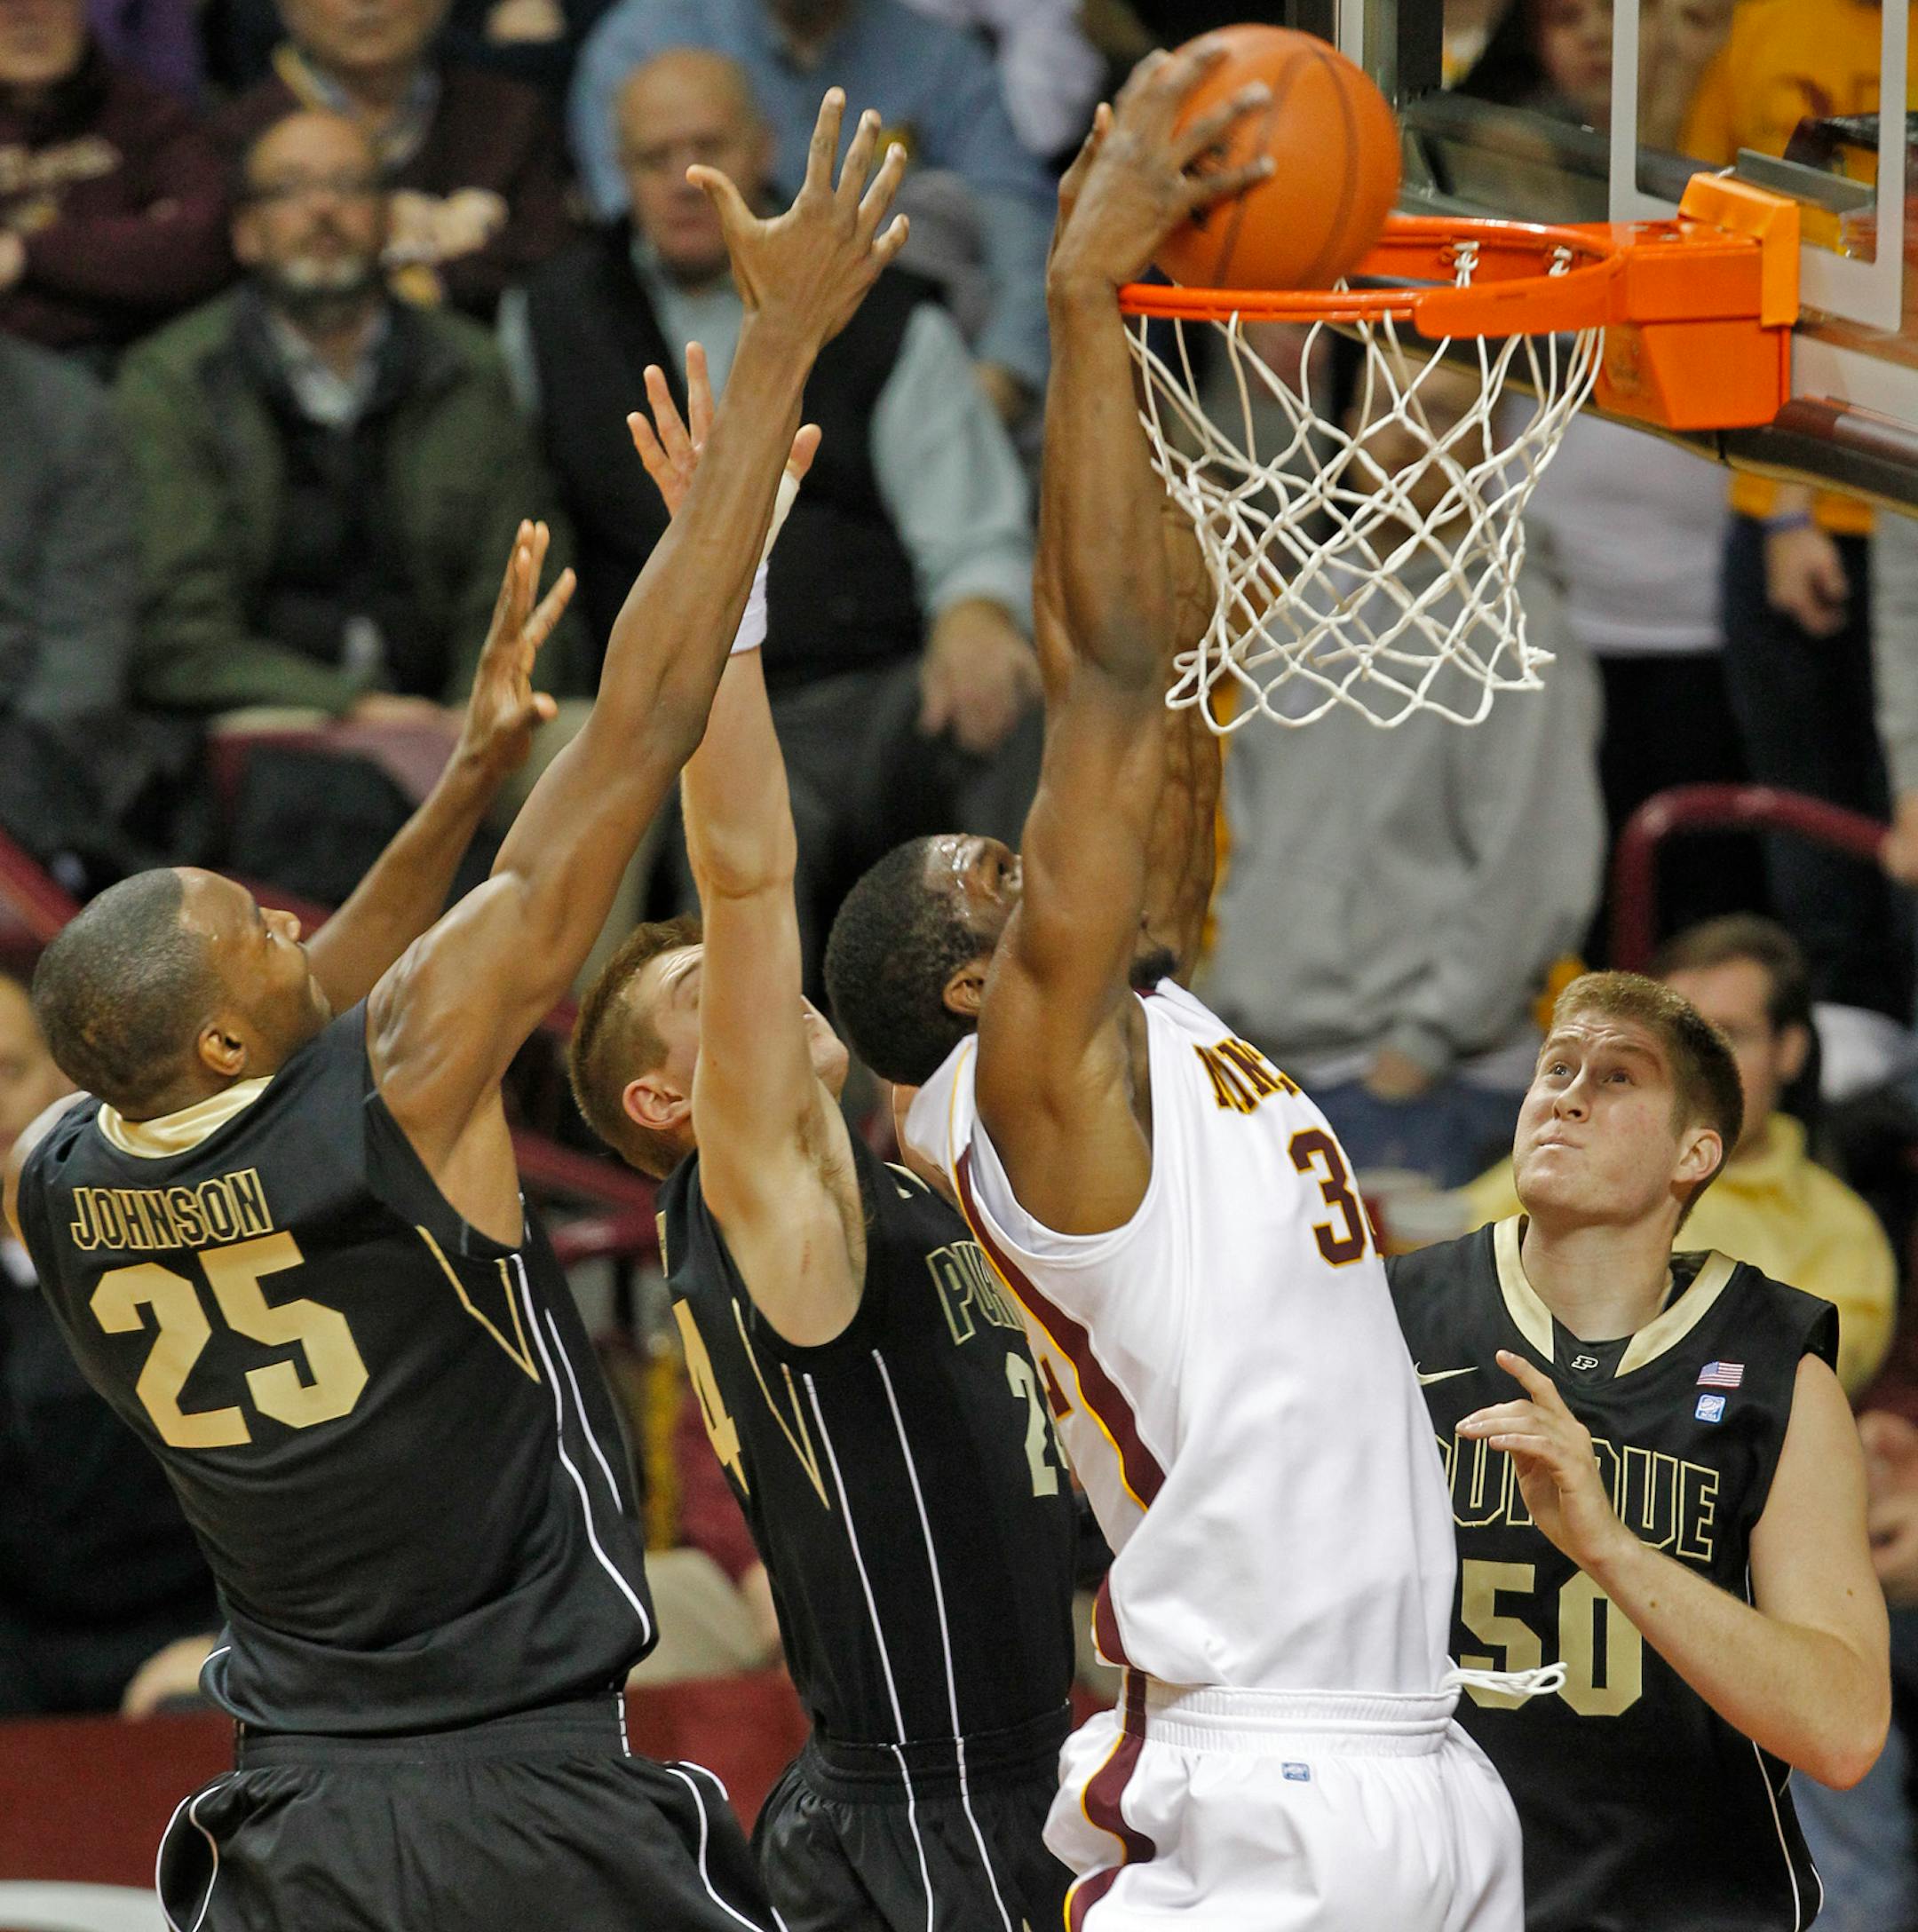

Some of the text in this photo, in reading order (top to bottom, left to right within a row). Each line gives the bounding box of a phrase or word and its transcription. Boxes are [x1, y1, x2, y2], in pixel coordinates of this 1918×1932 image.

[70, 1168, 274, 1250] JOHNSON
[1288, 1126, 1383, 1268] 3
[89, 1230, 370, 1449] 25
[1005, 1351, 1069, 1497] 2
[1459, 1557, 1643, 1717] 50
